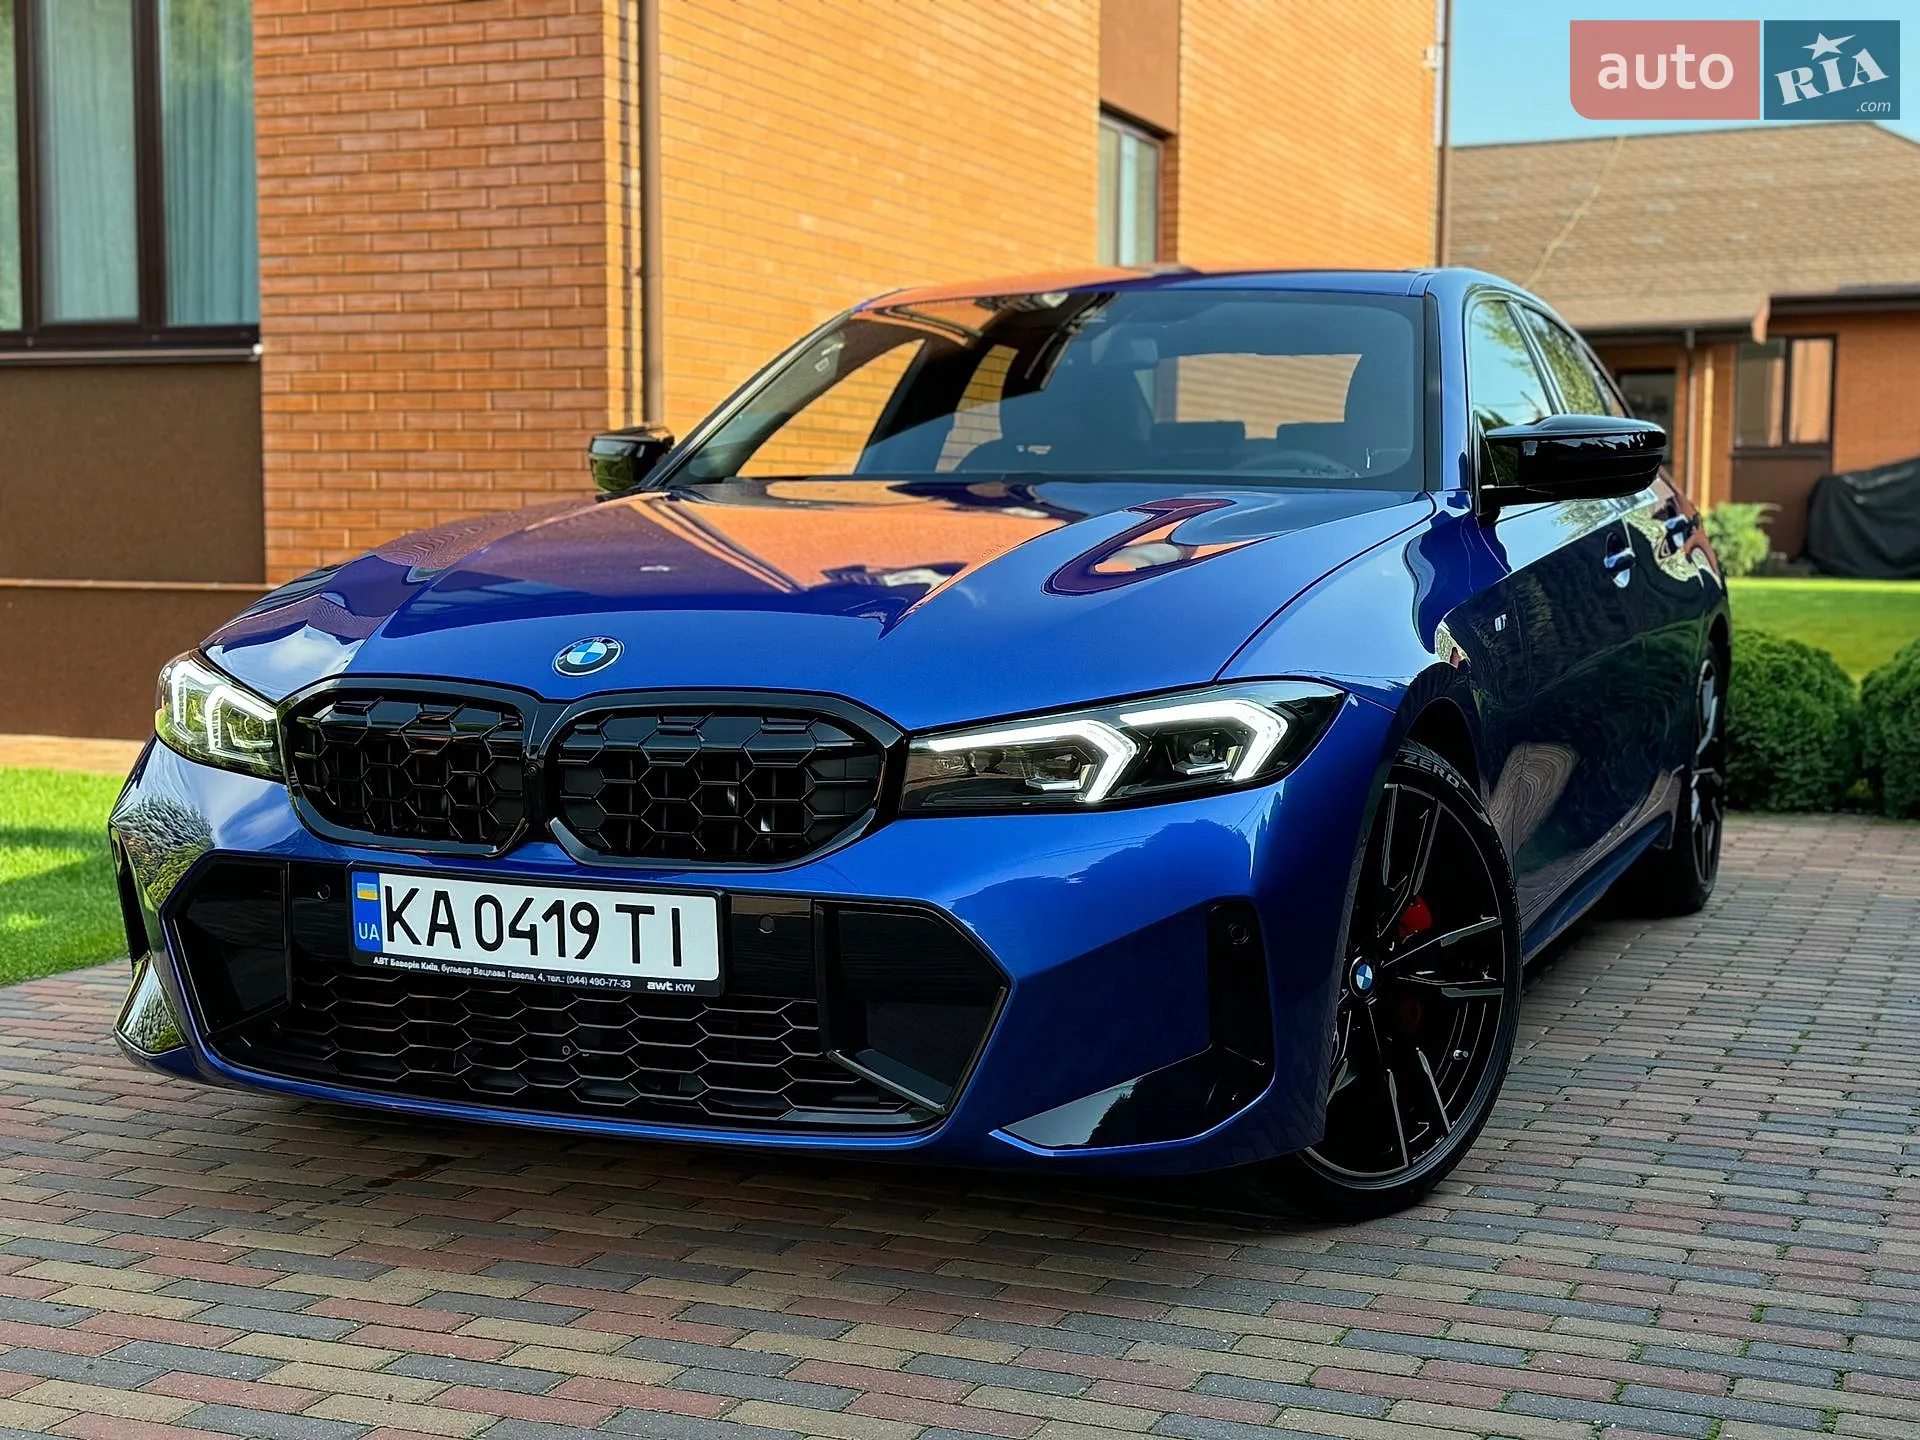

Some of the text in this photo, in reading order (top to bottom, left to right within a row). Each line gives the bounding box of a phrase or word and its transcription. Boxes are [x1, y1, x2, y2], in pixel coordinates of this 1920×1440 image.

[359, 922, 380, 941] UA
[385, 886, 682, 967] KA 0419 TI
[566, 975, 588, 985] (044)
[589, 976, 631, 988] 490-77-33
[647, 981, 695, 992] awt KYIV
